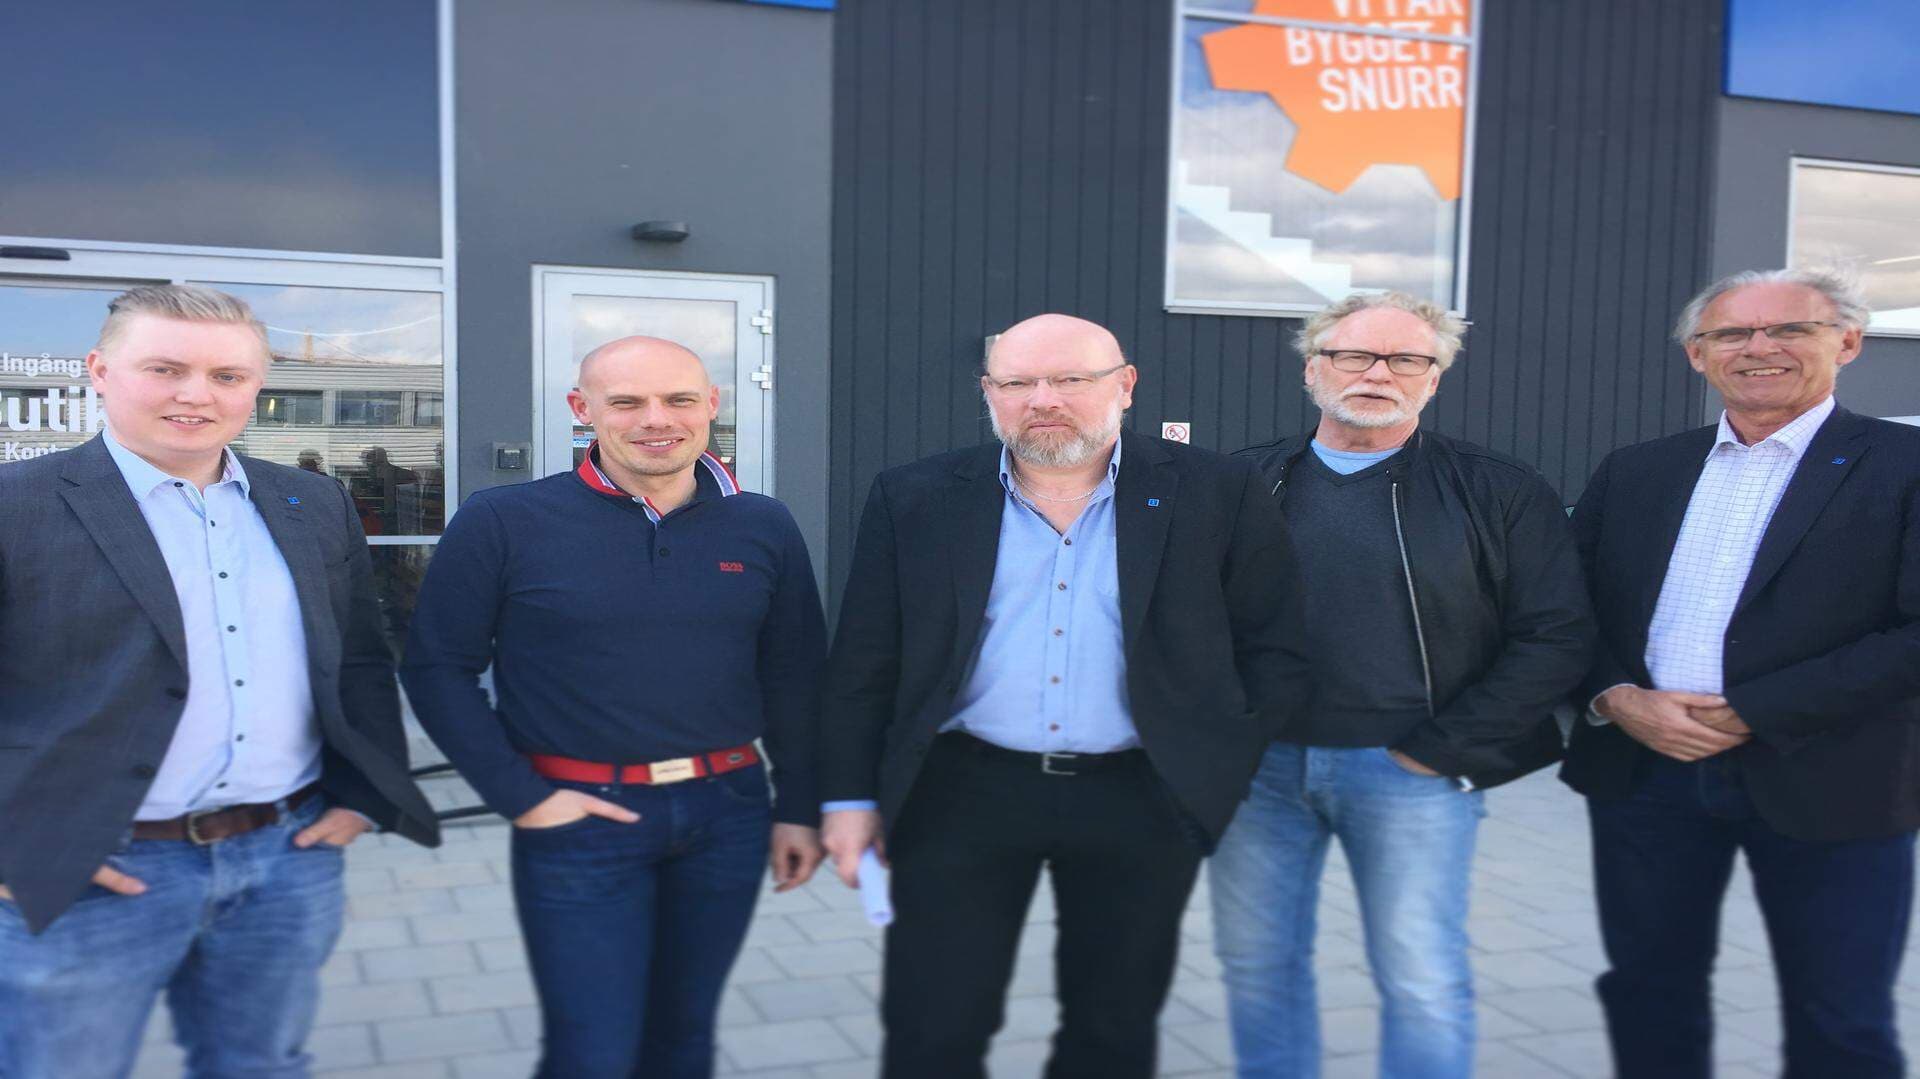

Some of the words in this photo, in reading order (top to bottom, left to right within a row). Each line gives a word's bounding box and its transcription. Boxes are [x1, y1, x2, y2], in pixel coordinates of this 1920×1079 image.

[1286, 21, 1435, 65] BYGGET
[1319, 65, 1464, 112] SNURR
[3, 352, 81, 378] Ingång
[0, 386, 106, 432] utik
